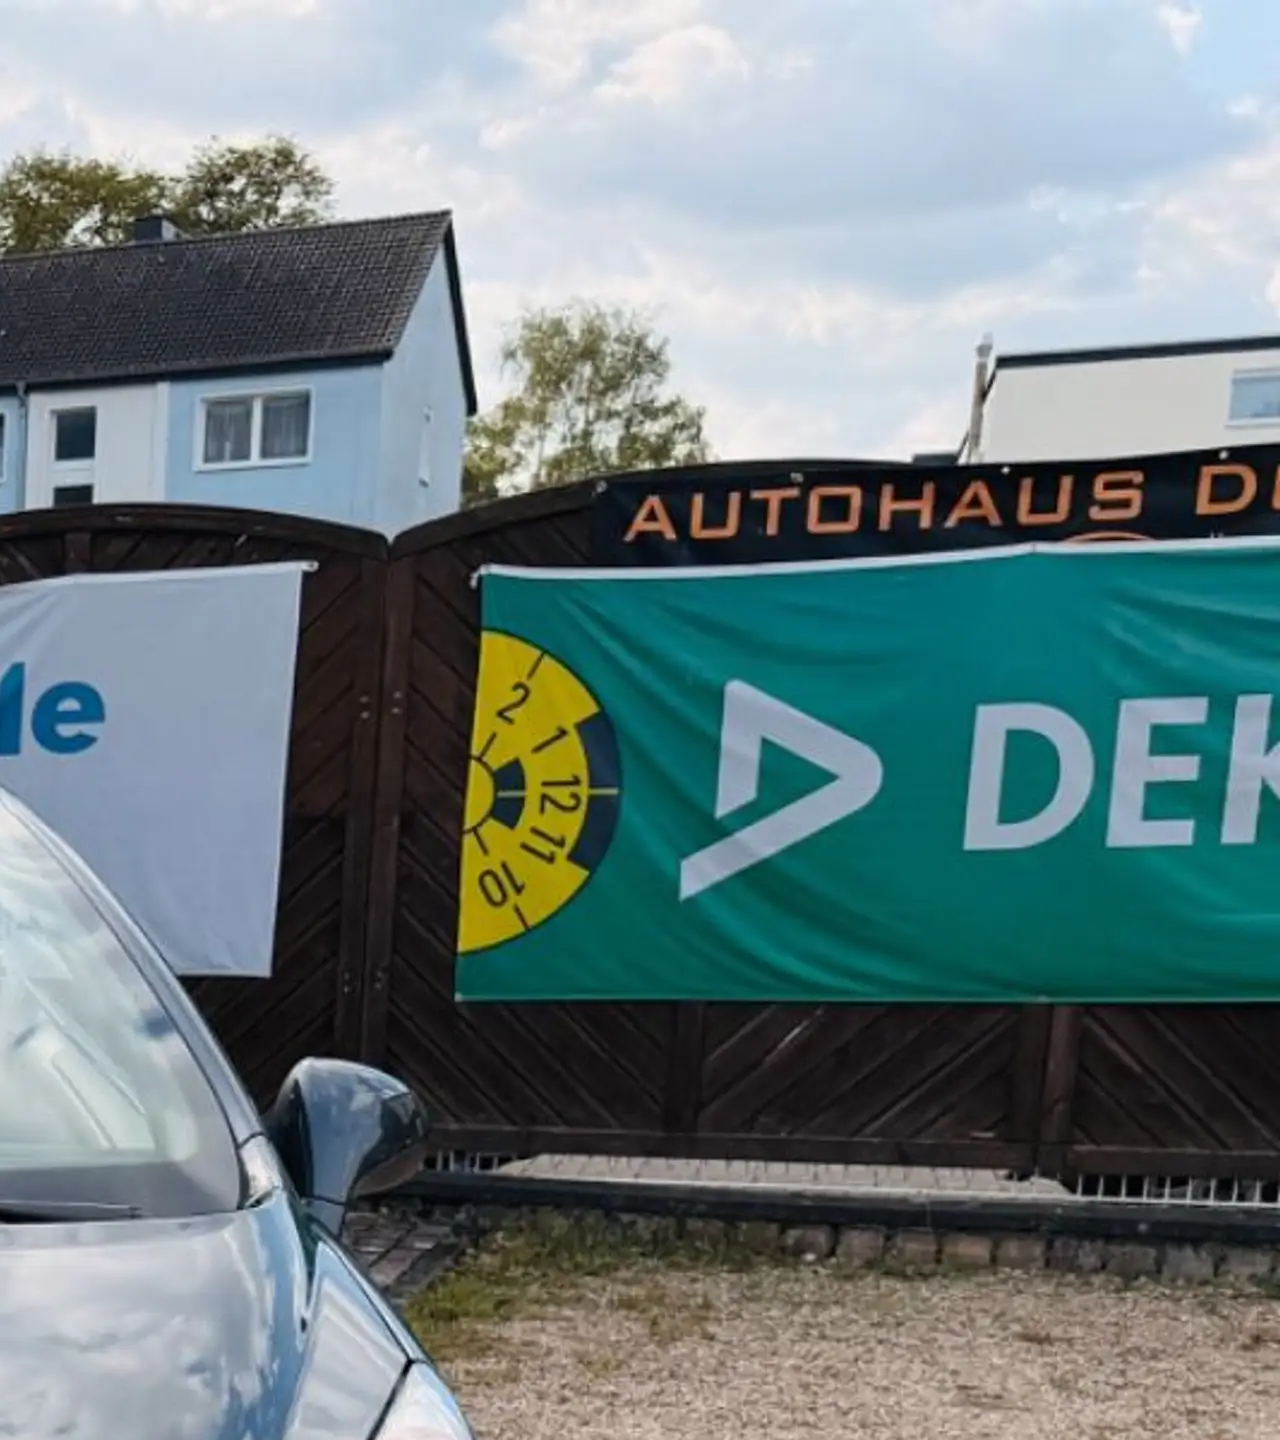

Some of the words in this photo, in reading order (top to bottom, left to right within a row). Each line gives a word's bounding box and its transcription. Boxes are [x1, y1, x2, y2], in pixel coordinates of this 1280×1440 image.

[624, 470, 1144, 543] AUTOHAUS
[1195, 463, 1280, 515] D
[496, 680, 533, 726] 2
[530, 725, 570, 754] 1
[540, 774, 582, 816] 12
[519, 825, 566, 866] 11
[477, 860, 526, 910] 10
